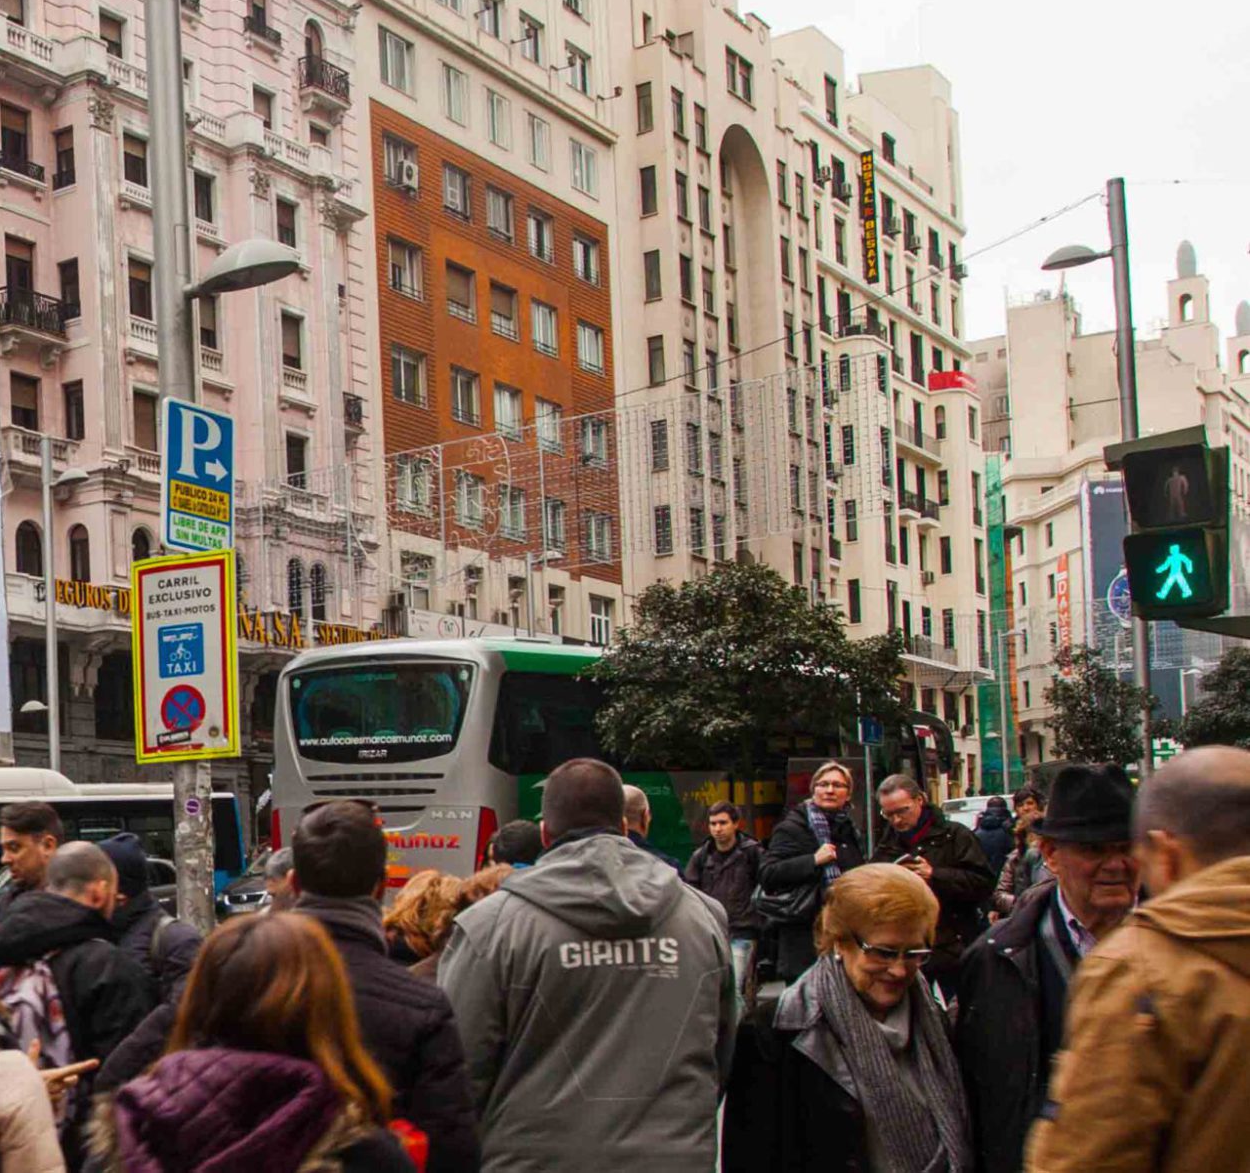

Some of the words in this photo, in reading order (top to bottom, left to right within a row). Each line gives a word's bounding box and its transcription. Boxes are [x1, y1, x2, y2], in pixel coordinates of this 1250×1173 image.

[862, 153, 873, 204] HOSTAL
[176, 407, 222, 479] P
[158, 576, 200, 589] CARRIL
[148, 587, 212, 604] EXCLUSIVO
[166, 661, 197, 675] TAXI
[358, 749, 388, 758] IRIZAR
[431, 810, 473, 820] MAN
[558, 937, 679, 968] GIANTS
